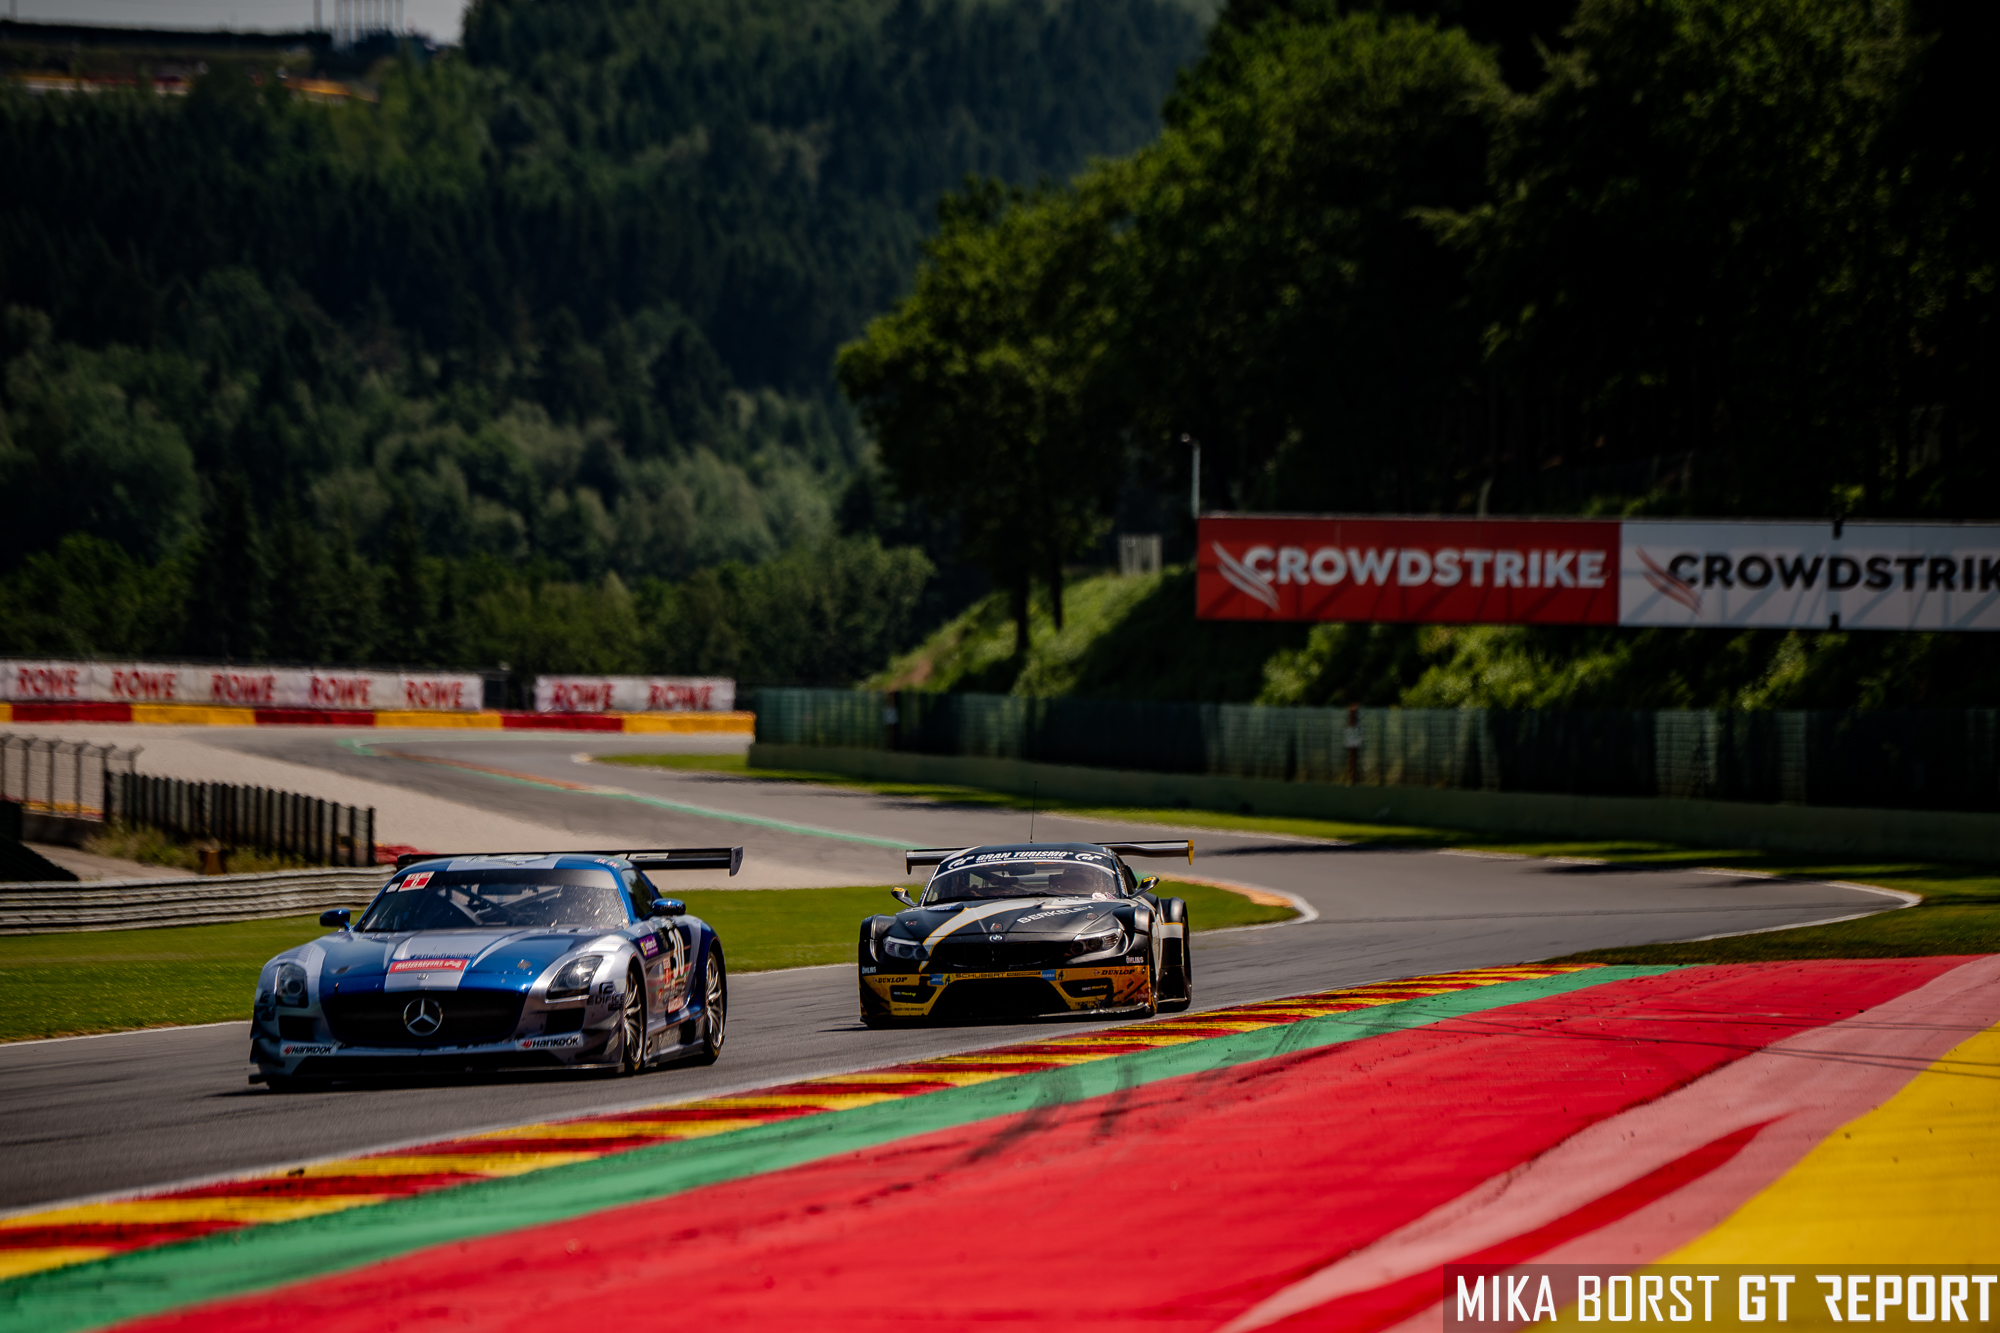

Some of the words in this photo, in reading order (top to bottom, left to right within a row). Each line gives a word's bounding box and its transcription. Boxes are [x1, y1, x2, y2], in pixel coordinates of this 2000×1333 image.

[1243, 546, 1607, 588] CROWDSTRIKE
[16, 666, 78, 698] ROWE
[111, 669, 176, 700] ROWE
[210, 672, 275, 703] ROWE
[308, 674, 373, 706] ROWE
[404, 680, 465, 708] ROWE
[552, 682, 615, 710] ROWE
[650, 684, 714, 711] ROWE
[976, 851, 1012, 861] GRAN
[877, 976, 908, 984] DUNLOP
